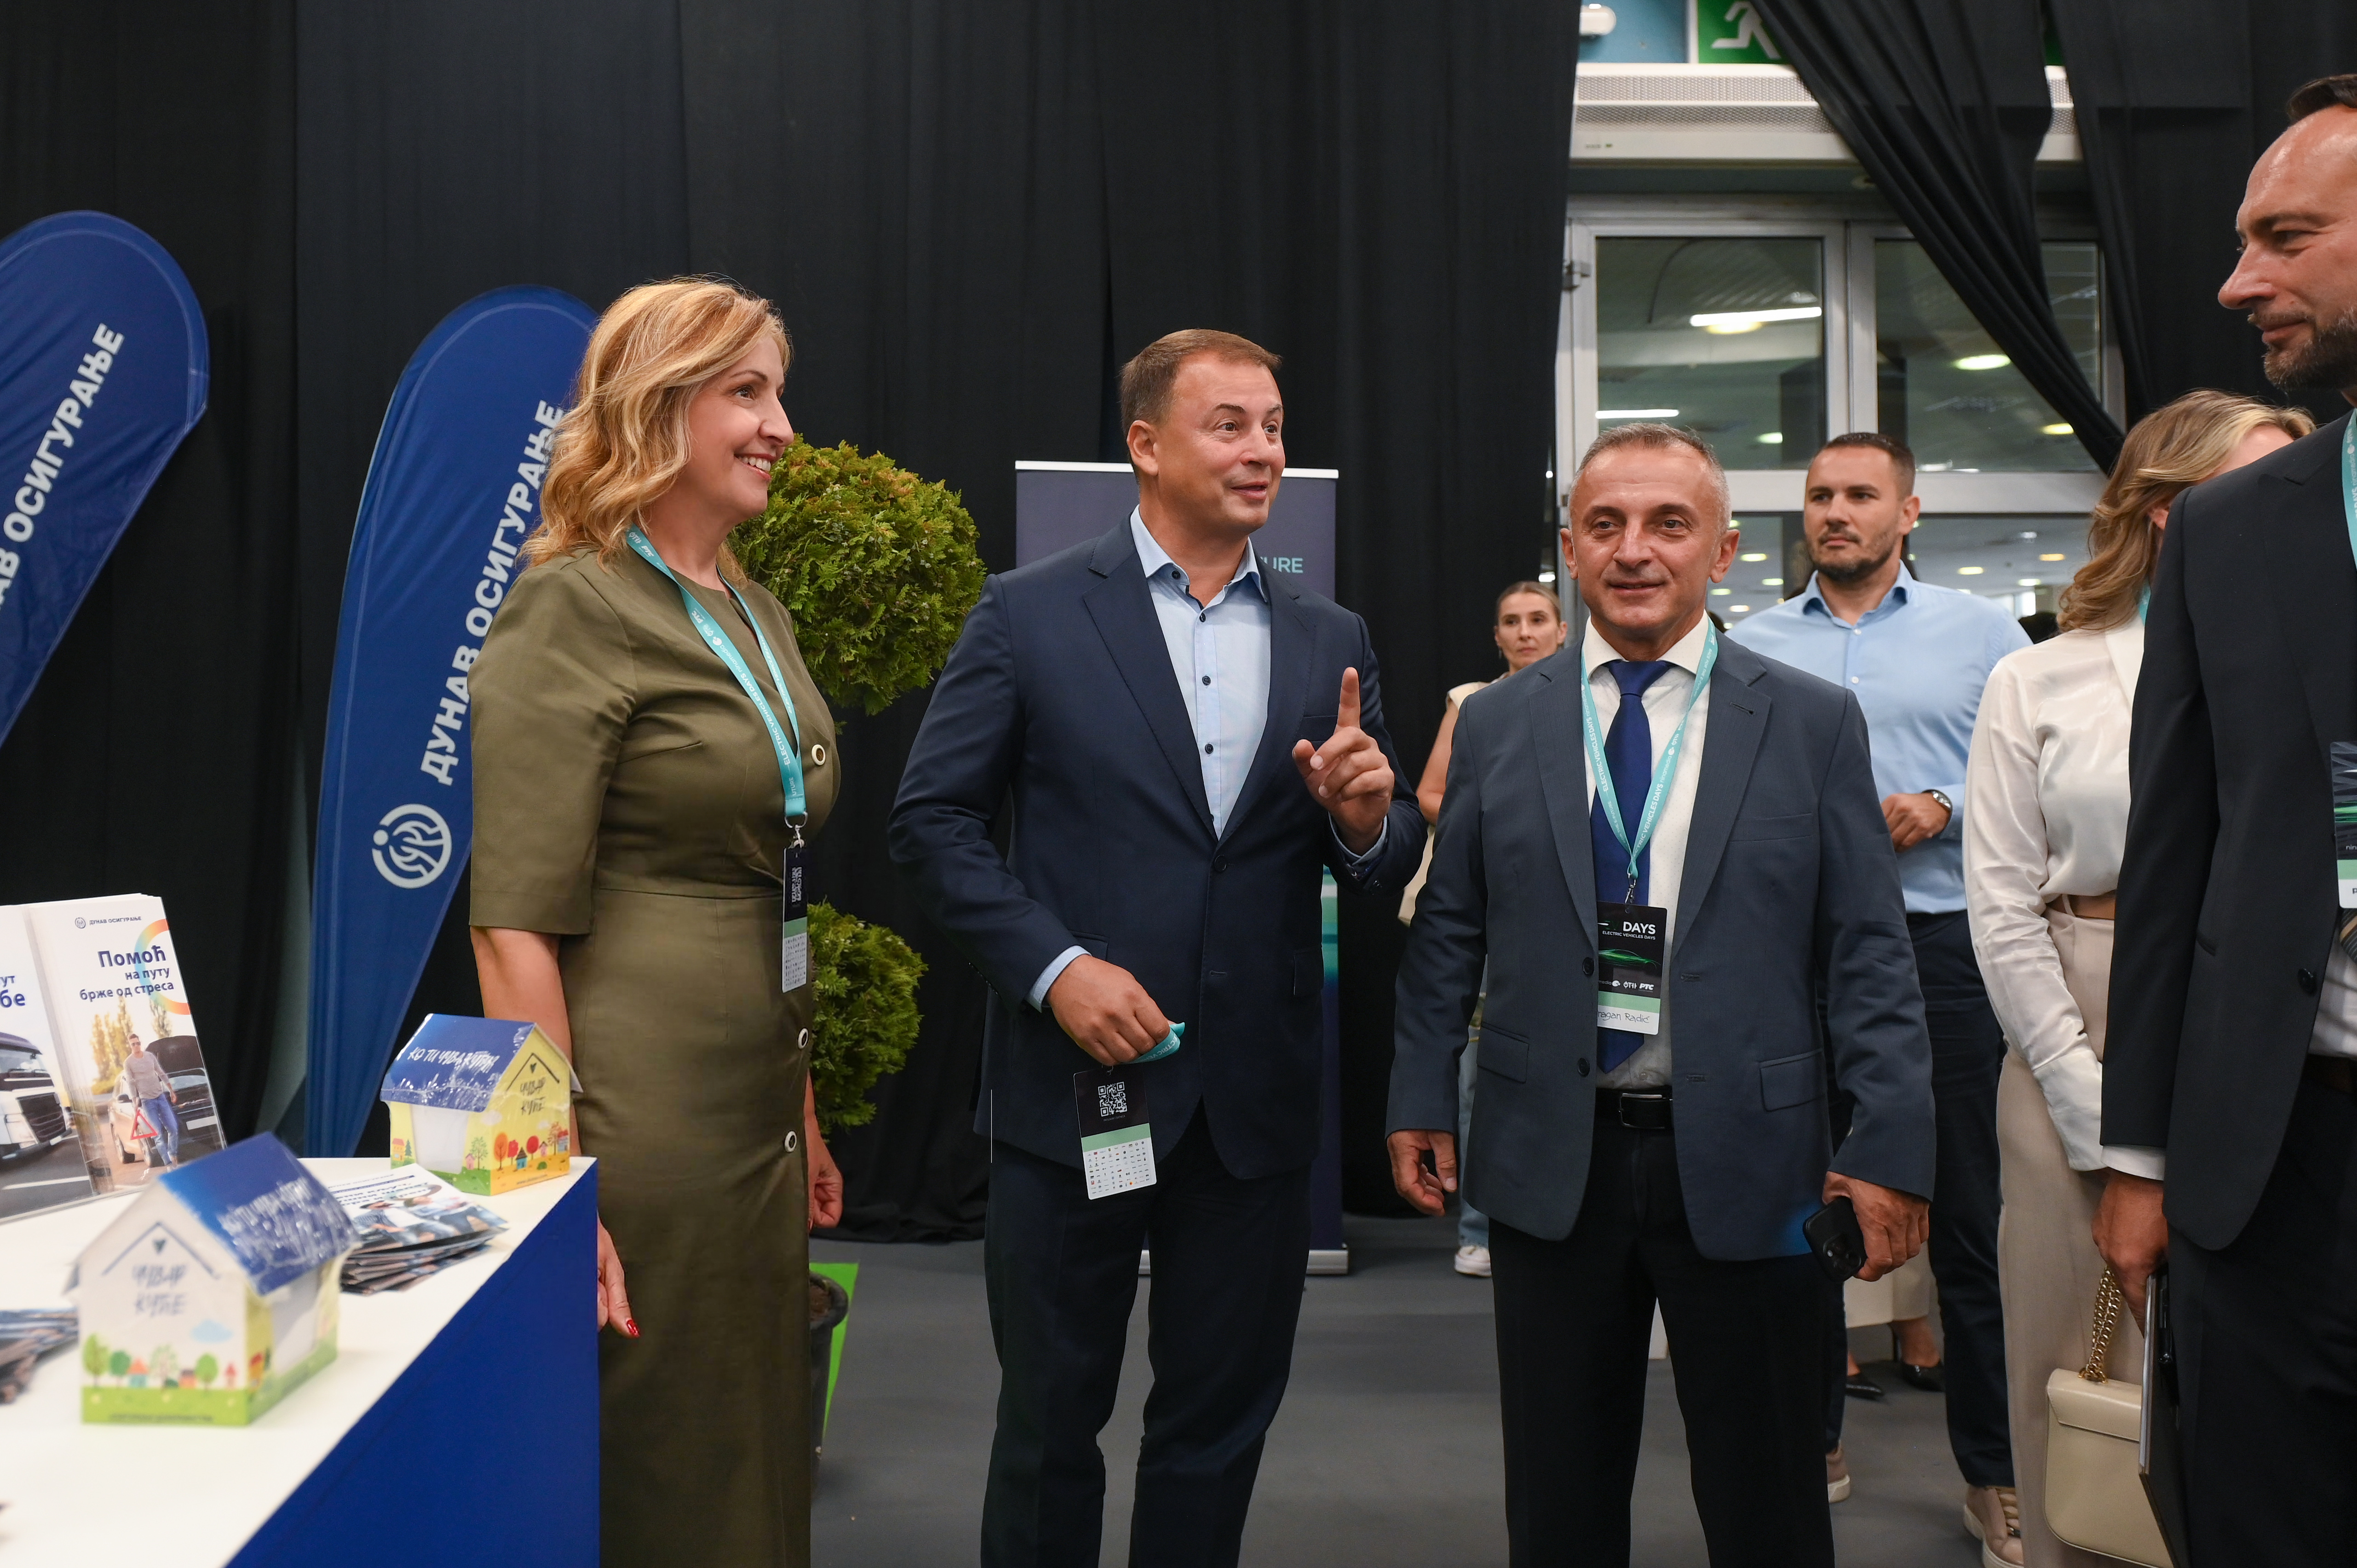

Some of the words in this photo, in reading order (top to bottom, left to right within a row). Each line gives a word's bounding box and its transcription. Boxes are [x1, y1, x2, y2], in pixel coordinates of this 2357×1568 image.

[3, 323, 125, 543] ОСИГУРАЊЕ
[1260, 556, 1303, 573] URE
[420, 645, 482, 785] ДУНАВ
[466, 399, 564, 638] ОСИГУРАЊЕ
[719, 644, 743, 672] ninamedia
[740, 673, 755, 692] DAYS
[753, 691, 775, 728] VEHICLES
[1586, 717, 1595, 735] DAYS
[772, 727, 790, 765] ELECTRIC
[1590, 733, 1601, 763] VEHICLES
[1596, 760, 1609, 792] ELECTRIC
[1643, 801, 1658, 833] VEHICLES
[1653, 784, 1664, 802] DAYS
[1660, 756, 1672, 783] ninamedia
[1623, 921, 1656, 935] DAYS
[98, 945, 166, 967] Помоћ
[125, 971, 140, 980] на
[142, 968, 170, 980] путу
[79, 988, 113, 1002] брже
[116, 988, 132, 998] од
[135, 982, 174, 995] стреса
[1157, 1033, 1178, 1055] ECTRIC
